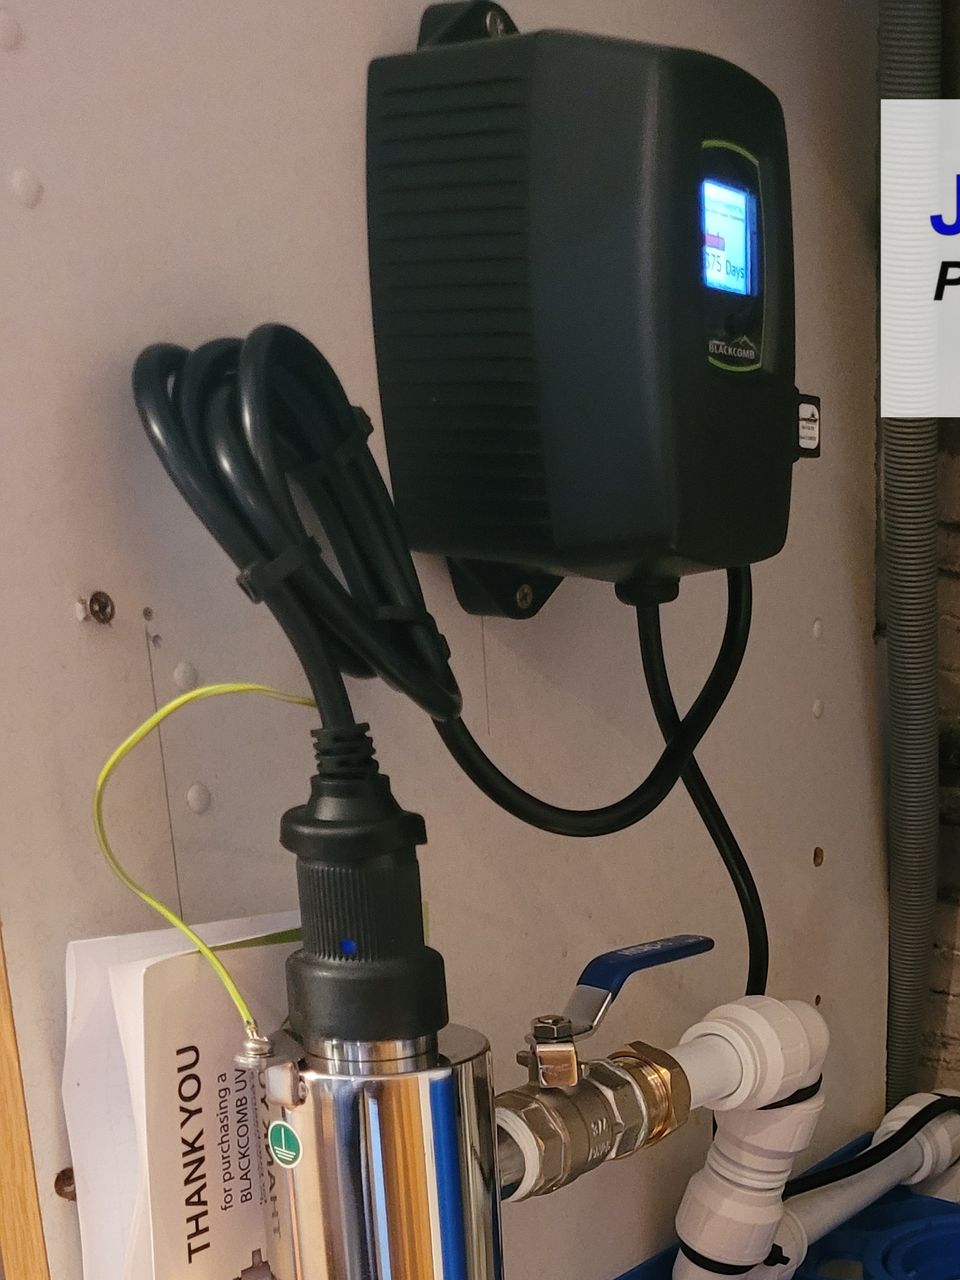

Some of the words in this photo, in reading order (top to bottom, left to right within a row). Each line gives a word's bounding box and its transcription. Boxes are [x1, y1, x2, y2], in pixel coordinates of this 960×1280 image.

[725, 258, 745, 282] Days
[708, 343, 756, 360] BLACKCOMB
[176, 1045, 203, 1129] YOU
[217, 1072, 228, 1083] a
[234, 1068, 247, 1093] UV
[215, 1085, 236, 1183] purchasing
[235, 1095, 253, 1204] BLACKCOMB
[180, 1128, 211, 1264] THANK
[221, 1185, 234, 1212] for
